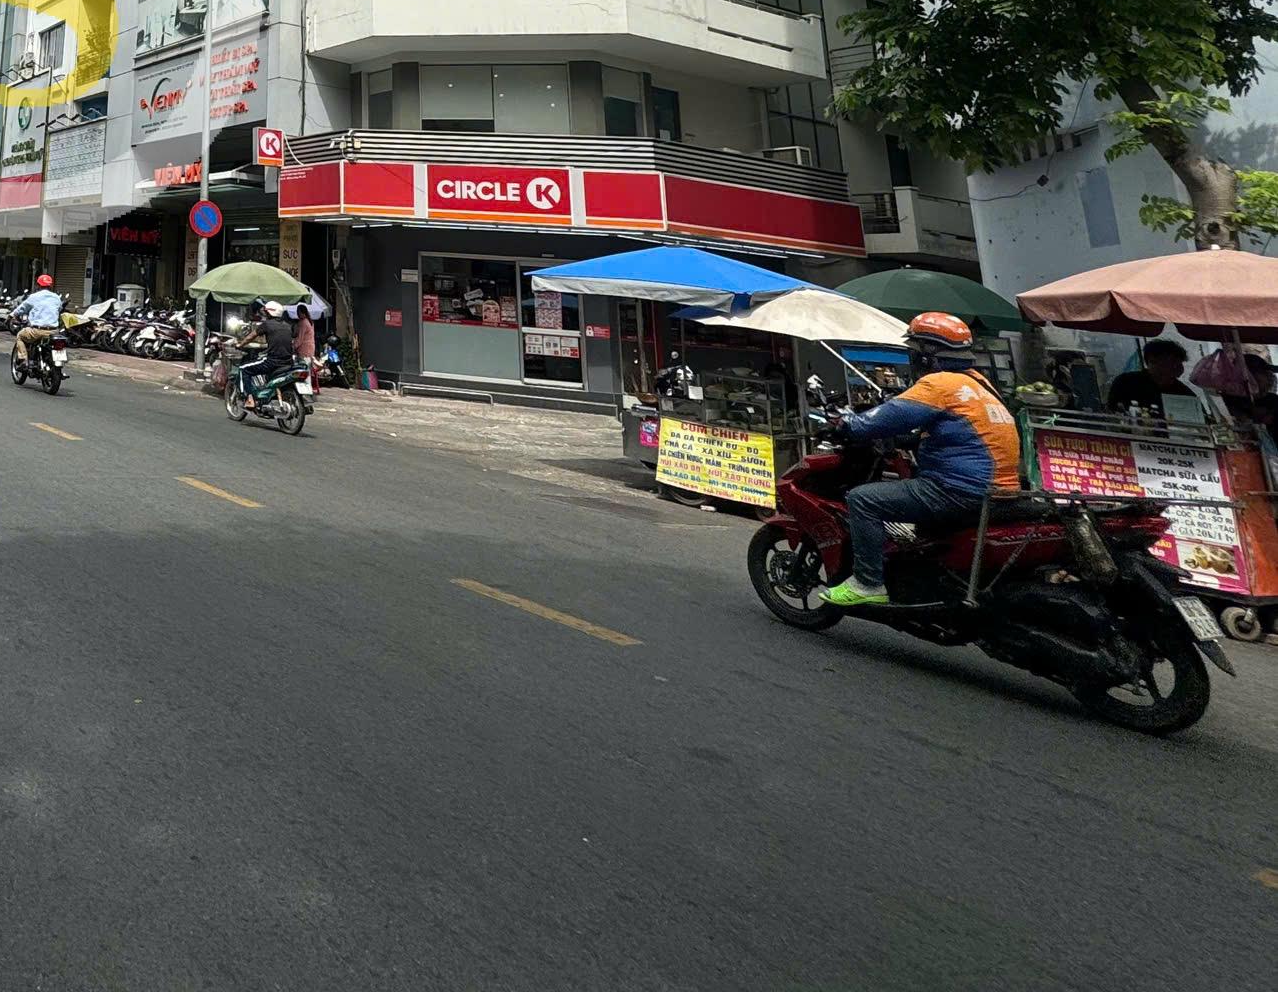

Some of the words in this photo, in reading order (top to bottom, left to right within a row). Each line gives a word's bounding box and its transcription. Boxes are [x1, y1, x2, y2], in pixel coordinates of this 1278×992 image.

[263, 134, 280, 155] K
[436, 179, 521, 202] CIRCLE
[532, 180, 561, 209] K
[1139, 443, 1177, 455] MATCHA
[1180, 448, 1210, 459] LATTE
[1157, 457, 1195, 469] 20K-25K
[1138, 466, 1176, 478] MATCHA
[1178, 470, 1197, 482] SỮA
[1162, 481, 1200, 494] 25K-30K
